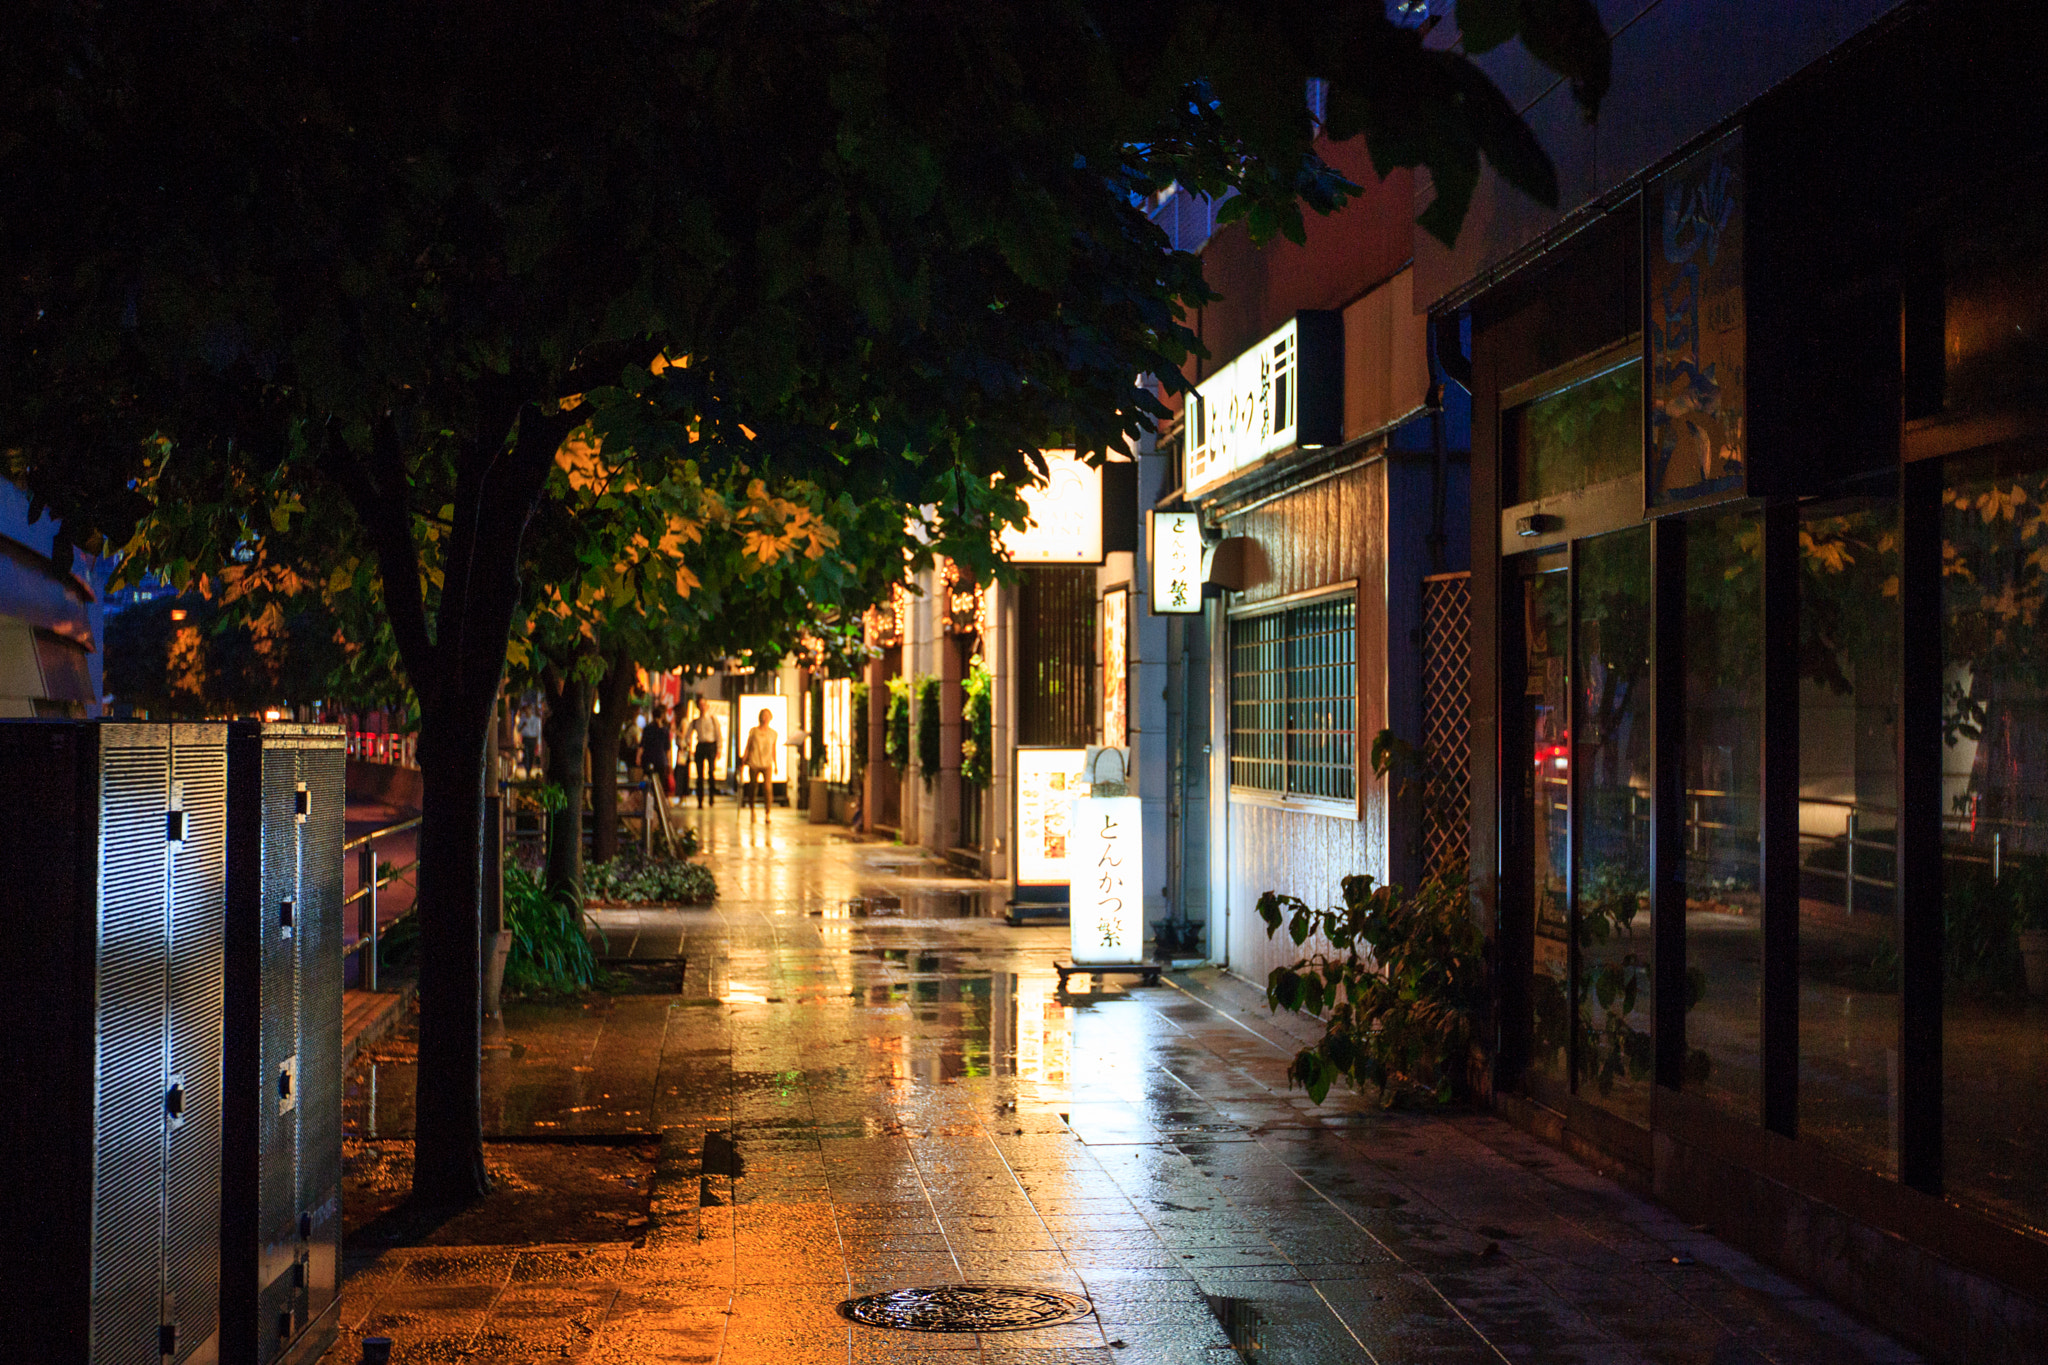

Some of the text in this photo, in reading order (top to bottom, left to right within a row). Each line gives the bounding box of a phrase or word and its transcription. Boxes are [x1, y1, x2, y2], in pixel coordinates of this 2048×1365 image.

[1167, 517, 1189, 607] とんかつ繁
[1097, 814, 1124, 948] とんかつ繁
